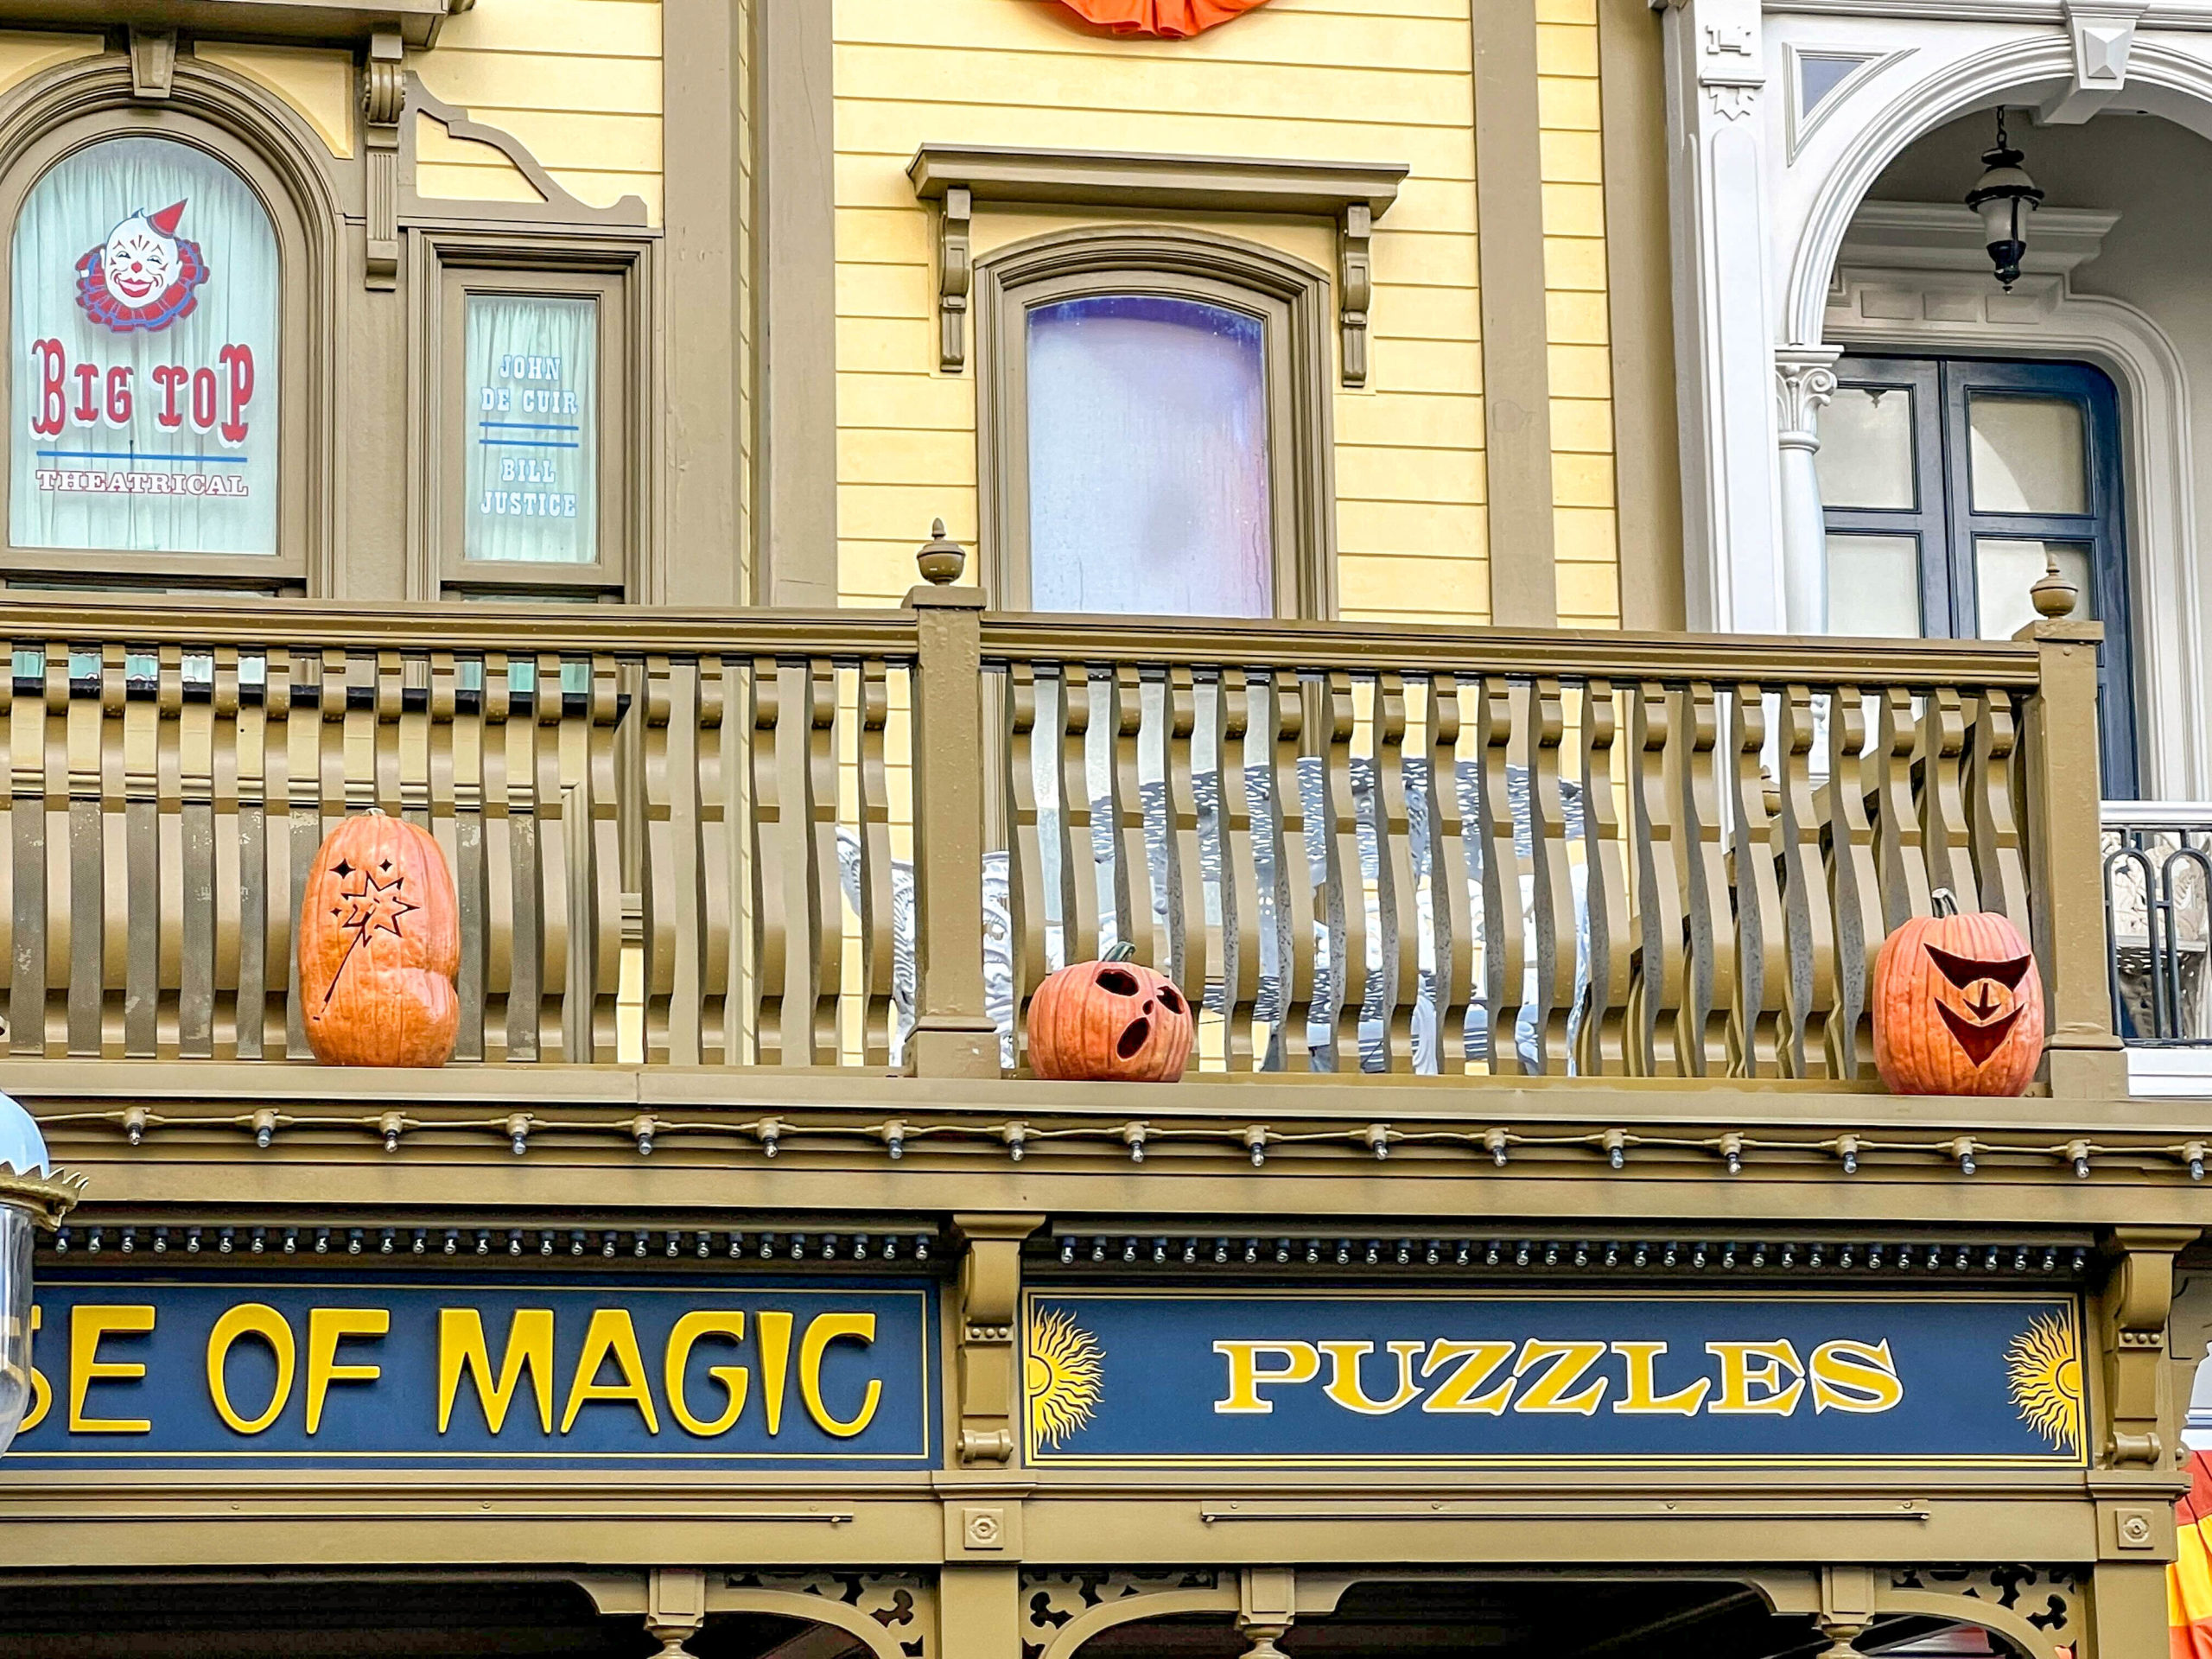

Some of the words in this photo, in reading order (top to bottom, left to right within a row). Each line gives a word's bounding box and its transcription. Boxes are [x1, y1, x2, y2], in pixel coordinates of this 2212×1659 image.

[499, 353, 562, 381] JOHN
[30, 337, 134, 440] BIG
[151, 342, 255, 446] TOP
[480, 386, 511, 412] DE
[522, 389, 580, 416] CUIR
[35, 469, 249, 497] THEATRICAL
[501, 457, 556, 483] BILL
[480, 490, 577, 518] JUSTICE
[206, 1302, 391, 1436] OF
[437, 1306, 883, 1438] MAGIC
[1211, 1337, 1905, 1417] PUZZLES
